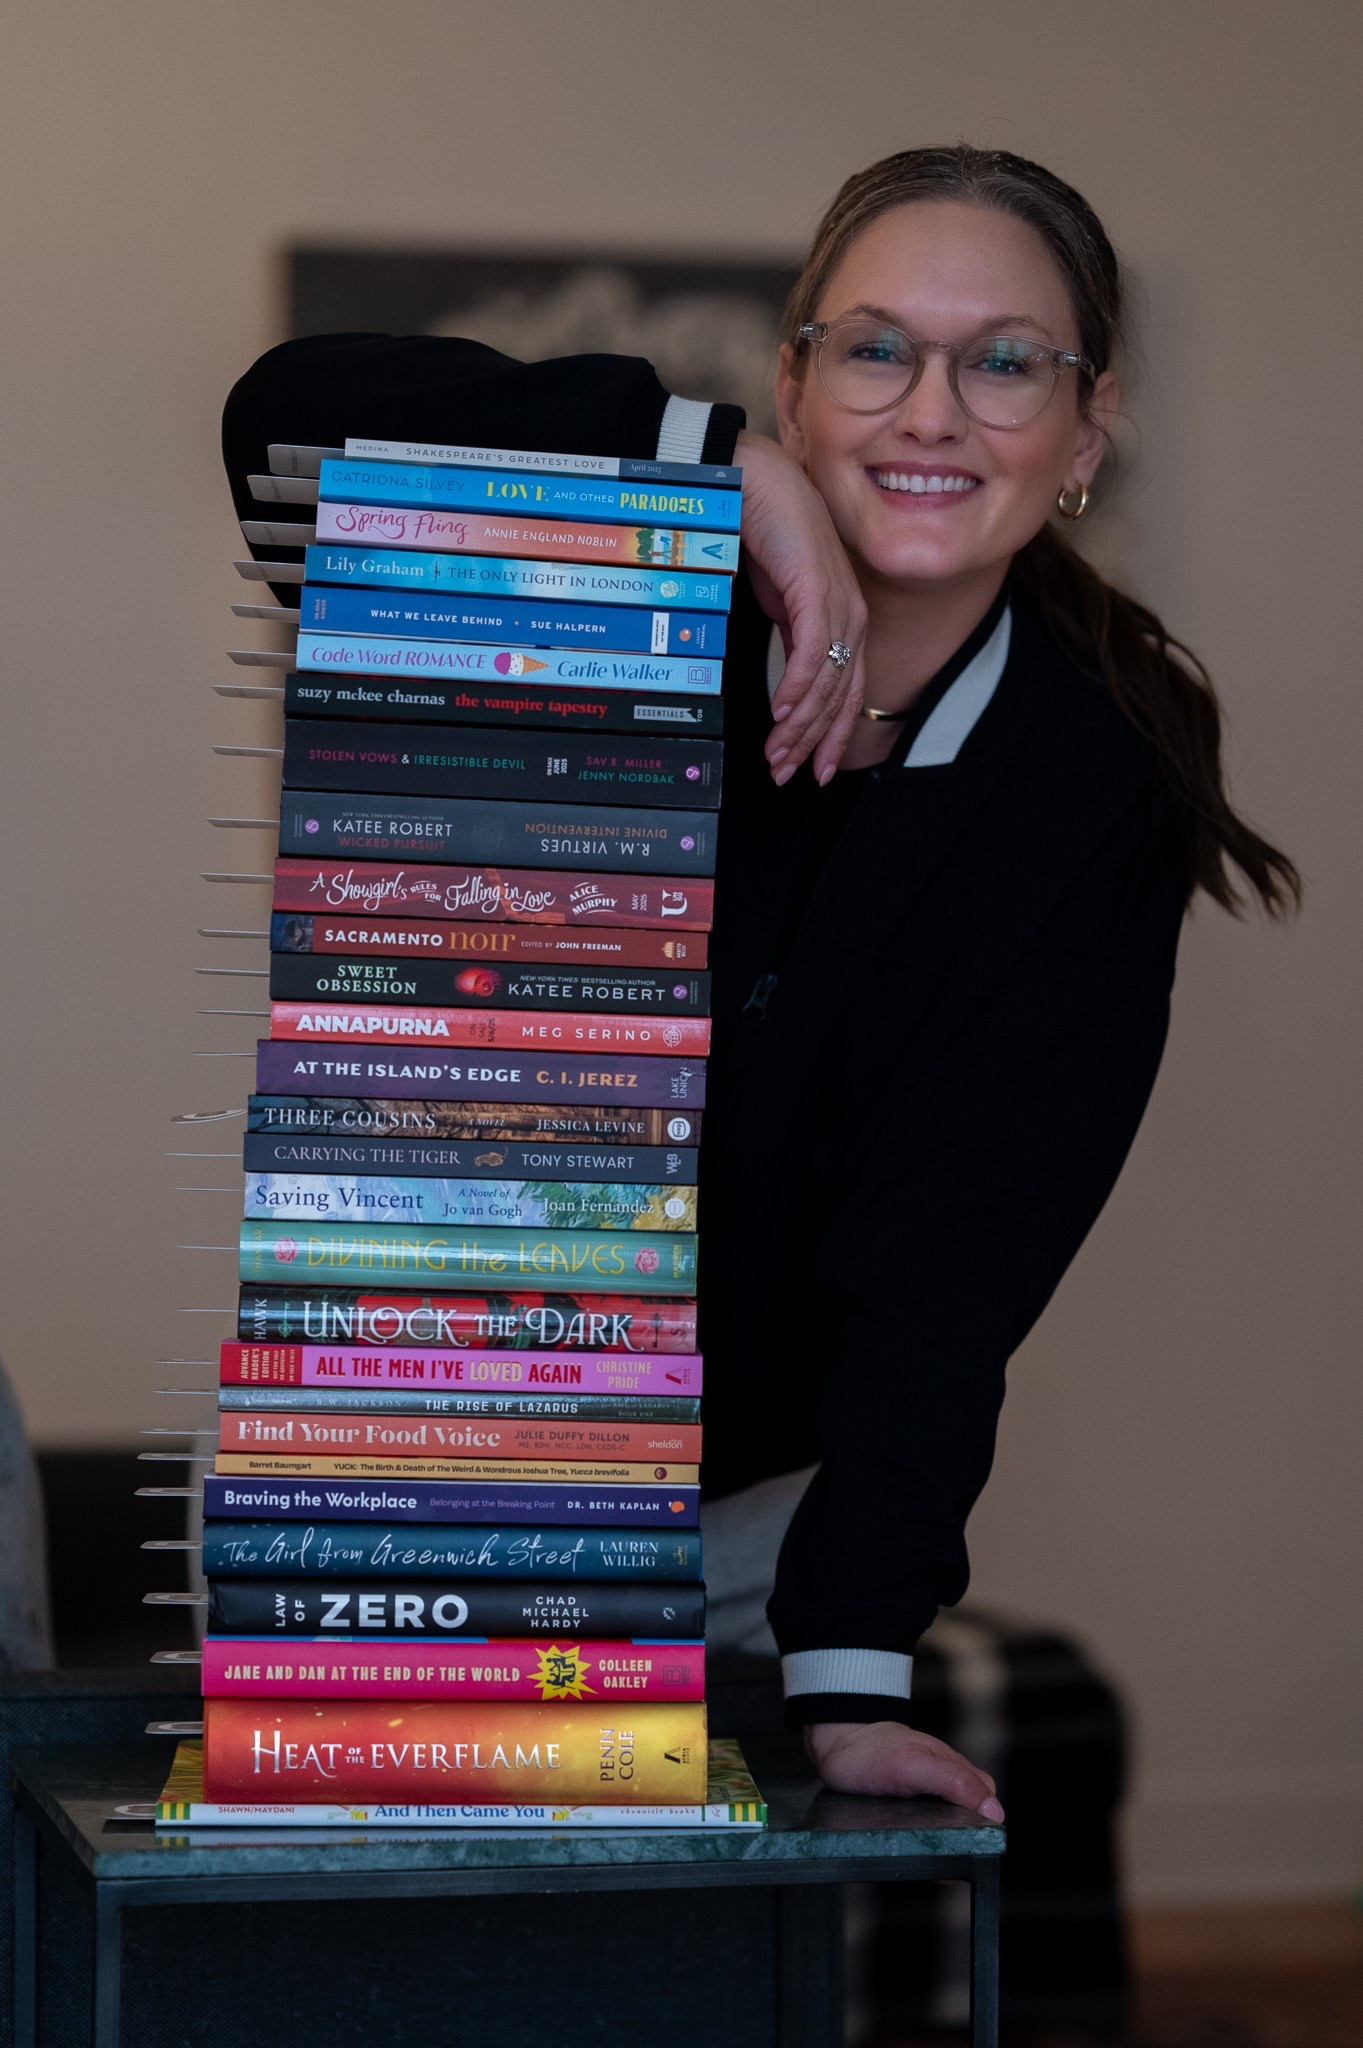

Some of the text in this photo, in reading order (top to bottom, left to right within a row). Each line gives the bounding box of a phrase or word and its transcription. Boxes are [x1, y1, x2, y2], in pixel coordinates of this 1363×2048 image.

[406, 448, 604, 469] SHAKESPEARE'S GREATEST LOVE
[332, 471, 465, 492] CATRIONA SILVEY
[335, 506, 468, 544] Spring Fling
[484, 528, 617, 547] ANNIE ENGLAND NOBLIN
[326, 556, 424, 576] Lily Graham
[448, 568, 654, 592] THE ONLY LIGHT IN LONDON
[371, 610, 502, 626] WHAT WE LEAVE BEHIND
[531, 621, 606, 633] SUE HALPERN
[312, 647, 486, 669] Code Word ROMANCE
[558, 661, 673, 681] Carlie Walker
[298, 687, 445, 705] suzy mckee charnas
[455, 694, 607, 718] the vampire tapestry
[309, 749, 525, 769] STOLEN VOWS & IRRESISTIBLE DEVIL
[333, 820, 453, 837] KATEE ROBERT
[525, 824, 667, 839] DIVINE INTERVENTION
[570, 885, 598, 902] ALICE
[572, 898, 617, 916] MURPHY
[325, 930, 516, 952] SACRAMENTO noir
[337, 965, 397, 979] SWEET
[317, 979, 417, 994] OBSESSION
[509, 984, 665, 1001] KATEE ROBERT
[296, 1014, 450, 1036] ANNAPURNA
[522, 1026, 651, 1040] MEG SERINO
[294, 1061, 521, 1083] AT THE ISLAND'S EDGE
[264, 1108, 436, 1129] THREE COUSINS
[274, 1146, 460, 1164] CARRYING THE TIGER
[256, 1185, 423, 1212] Saving Vincent
[308, 1237, 624, 1274] DIVINING the LEAVES
[255, 1298, 268, 1340] HAWK
[303, 1301, 645, 1351] UNLOCK THE DARK
[241, 1349, 249, 1379] ADVANCE
[251, 1348, 259, 1380] READER'S
[316, 1356, 582, 1384] ALL THE MEN I'VE LOVED AGAIN
[596, 1361, 652, 1374] CHRISTINE
[608, 1377, 639, 1389] PRIDE
[425, 1400, 578, 1414] THE RISE OF LAZARUS
[239, 1420, 500, 1447] Find Your Food Voice
[514, 1431, 629, 1442] JULIE DUFFY DILLON
[648, 1440, 682, 1449] sheldon
[249, 1461, 311, 1470] Barret Baumgart
[334, 1463, 358, 1471] YUCK:
[403, 1464, 425, 1472] Death
[452, 1465, 474, 1473] Weird
[523, 1467, 548, 1475] Joshua
[570, 1468, 592, 1476] Yucca
[224, 1490, 417, 1511] Braving the Workplace
[589, 1502, 615, 1510] BETH
[620, 1502, 659, 1510] KAPLAN
[223, 1527, 585, 1572] The Girl from Greenwich Street
[600, 1542, 658, 1553] LAUREN
[603, 1555, 655, 1567] WILLIG
[536, 1596, 577, 1605] CHAD
[276, 1594, 286, 1627] LAW
[295, 1600, 305, 1621] OF
[320, 1594, 468, 1629] ZERO
[523, 1608, 589, 1617] MICHAEL
[531, 1619, 581, 1628] HARDY
[599, 1660, 652, 1672] COLLEEN
[604, 1676, 648, 1688] OAKLEY
[251, 1730, 560, 1778] HEAT OF THE EVERFLAME
[600, 1729, 614, 1781] PENN
[619, 1730, 634, 1780] COLE
[374, 1805, 545, 1818] And Then Came You
